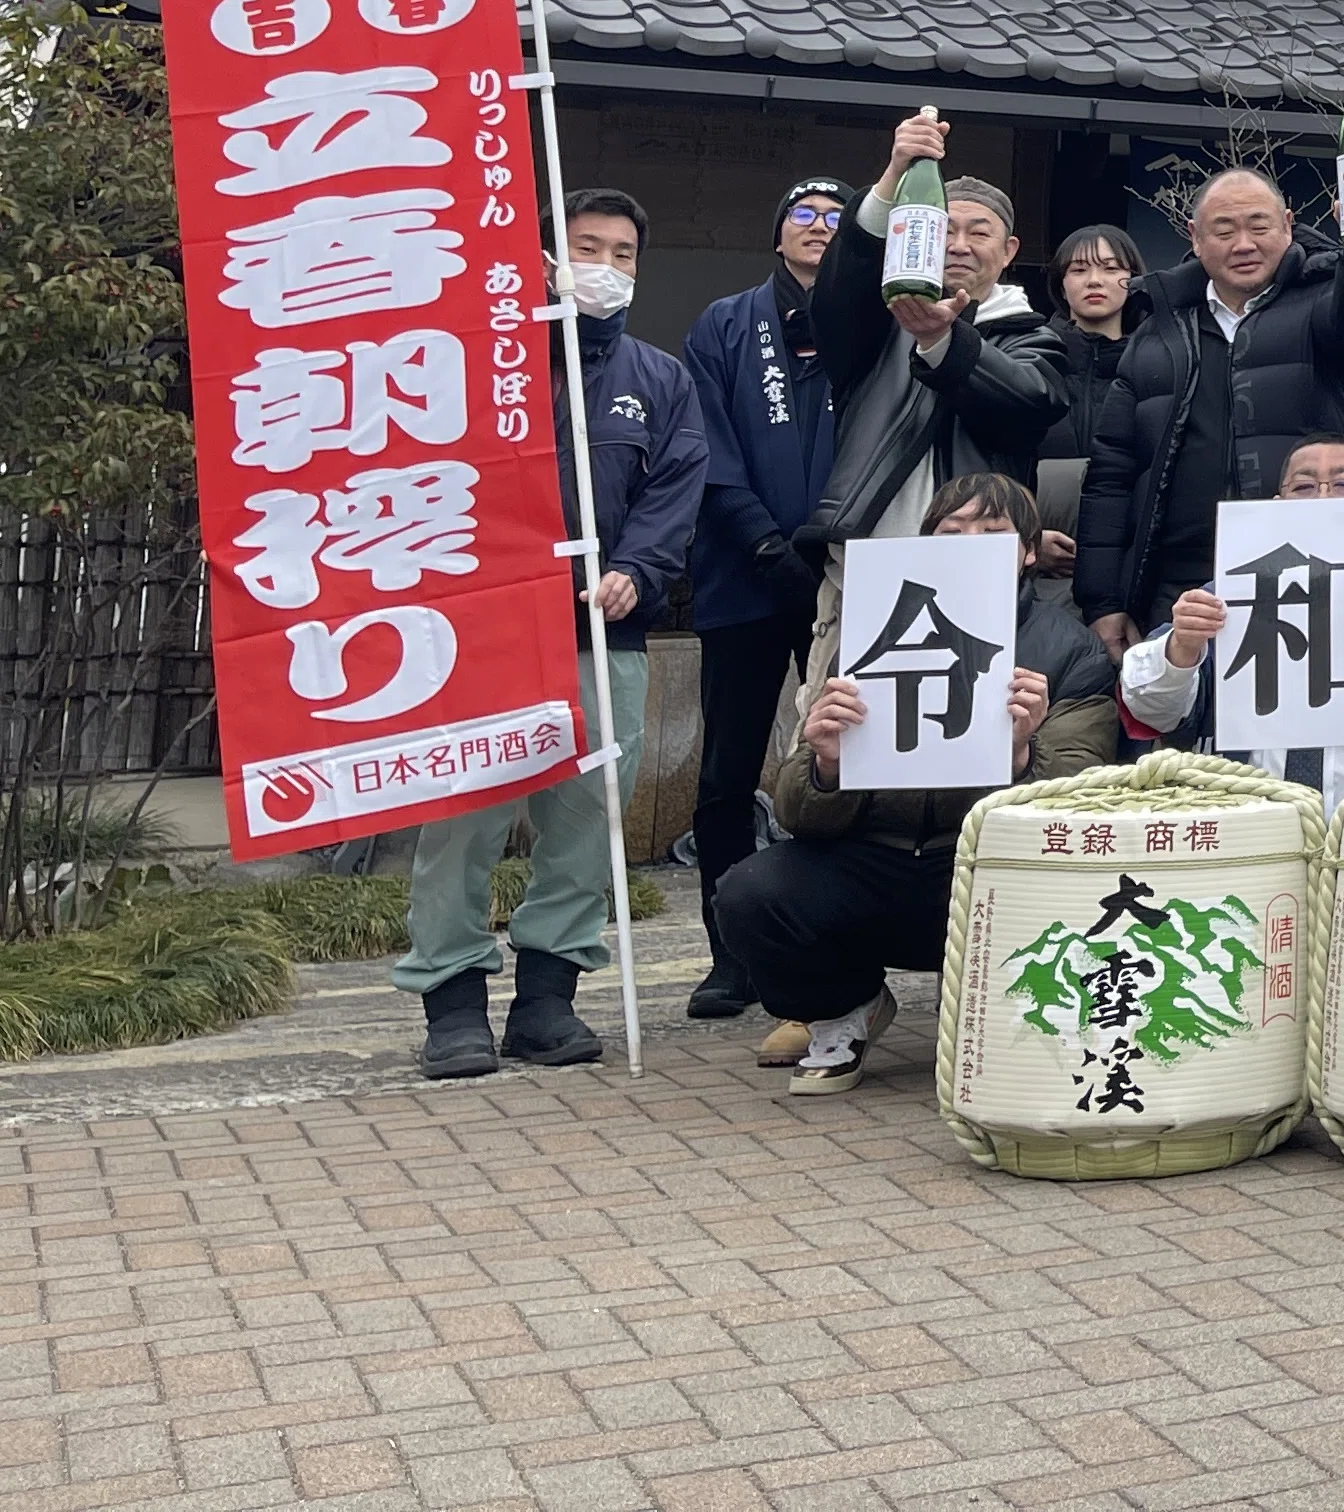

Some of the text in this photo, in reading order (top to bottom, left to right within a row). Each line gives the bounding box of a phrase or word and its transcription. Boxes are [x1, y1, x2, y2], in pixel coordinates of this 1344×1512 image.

[470, 70, 530, 442] りっしゅん あさしぼり
[844, 580, 1004, 753] 令
[352, 722, 561, 794] 日本名門酒会
[1041, 820, 1221, 855] 登録 商標
[1267, 915, 1294, 1001] 清酒
